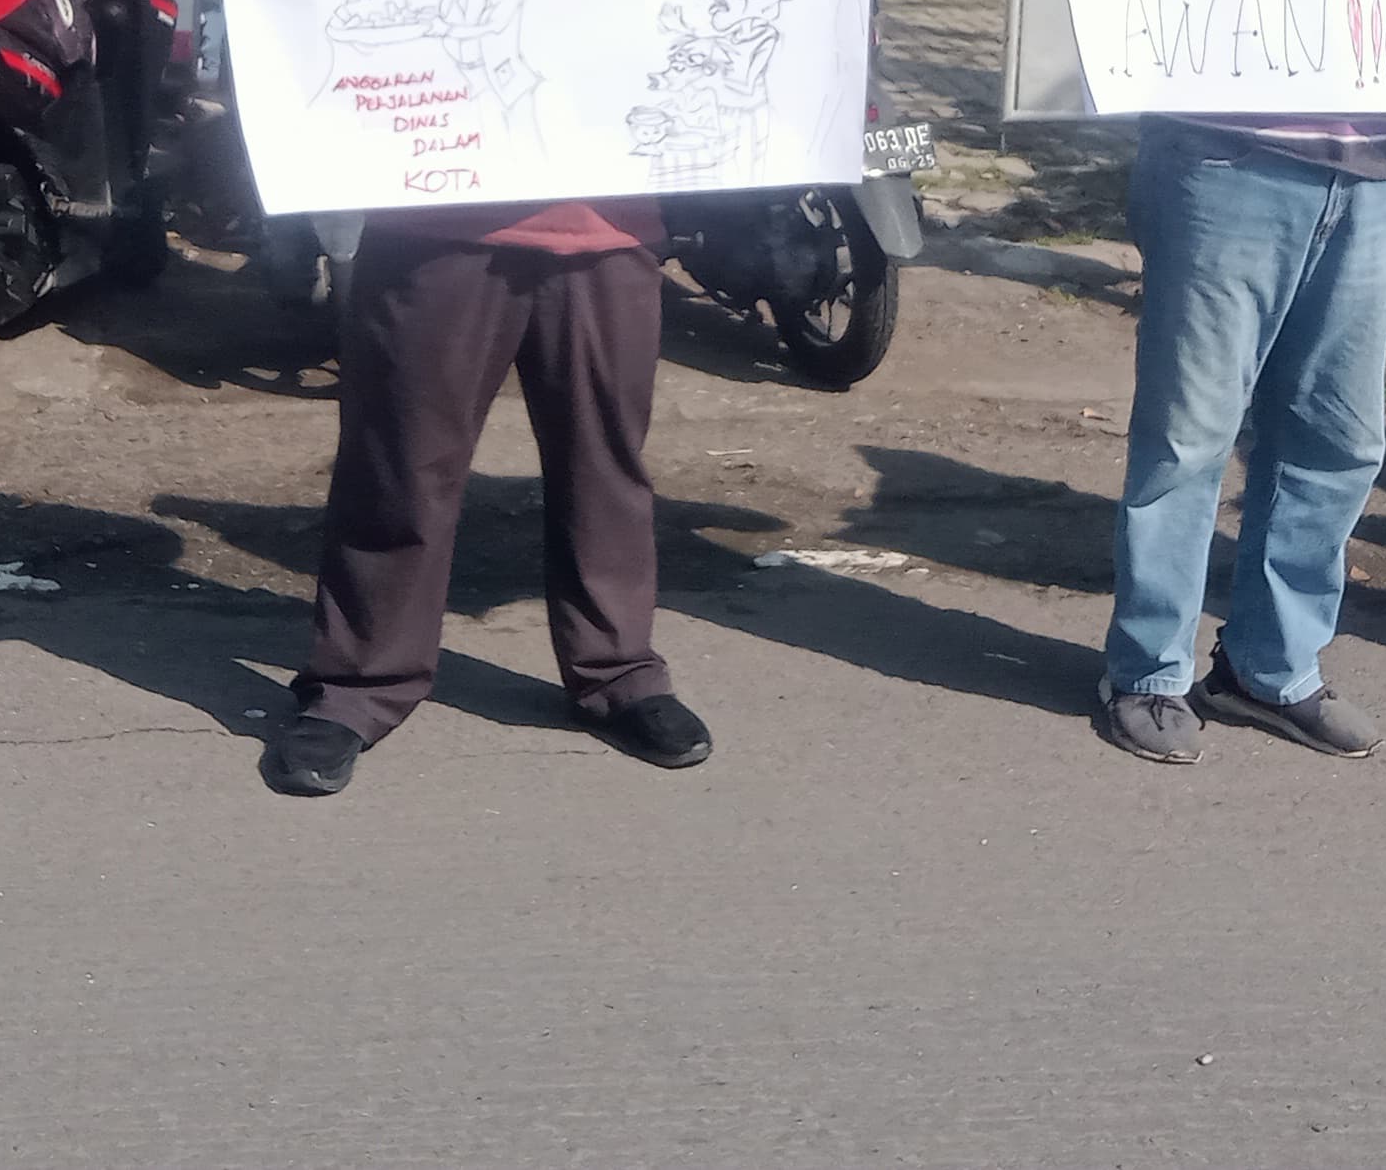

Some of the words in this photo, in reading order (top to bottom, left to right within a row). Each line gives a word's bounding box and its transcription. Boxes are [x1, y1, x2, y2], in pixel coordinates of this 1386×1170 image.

[393, 113, 450, 132] DINAS
[413, 132, 480, 157] DALAM
[405, 168, 481, 193] KOTA
